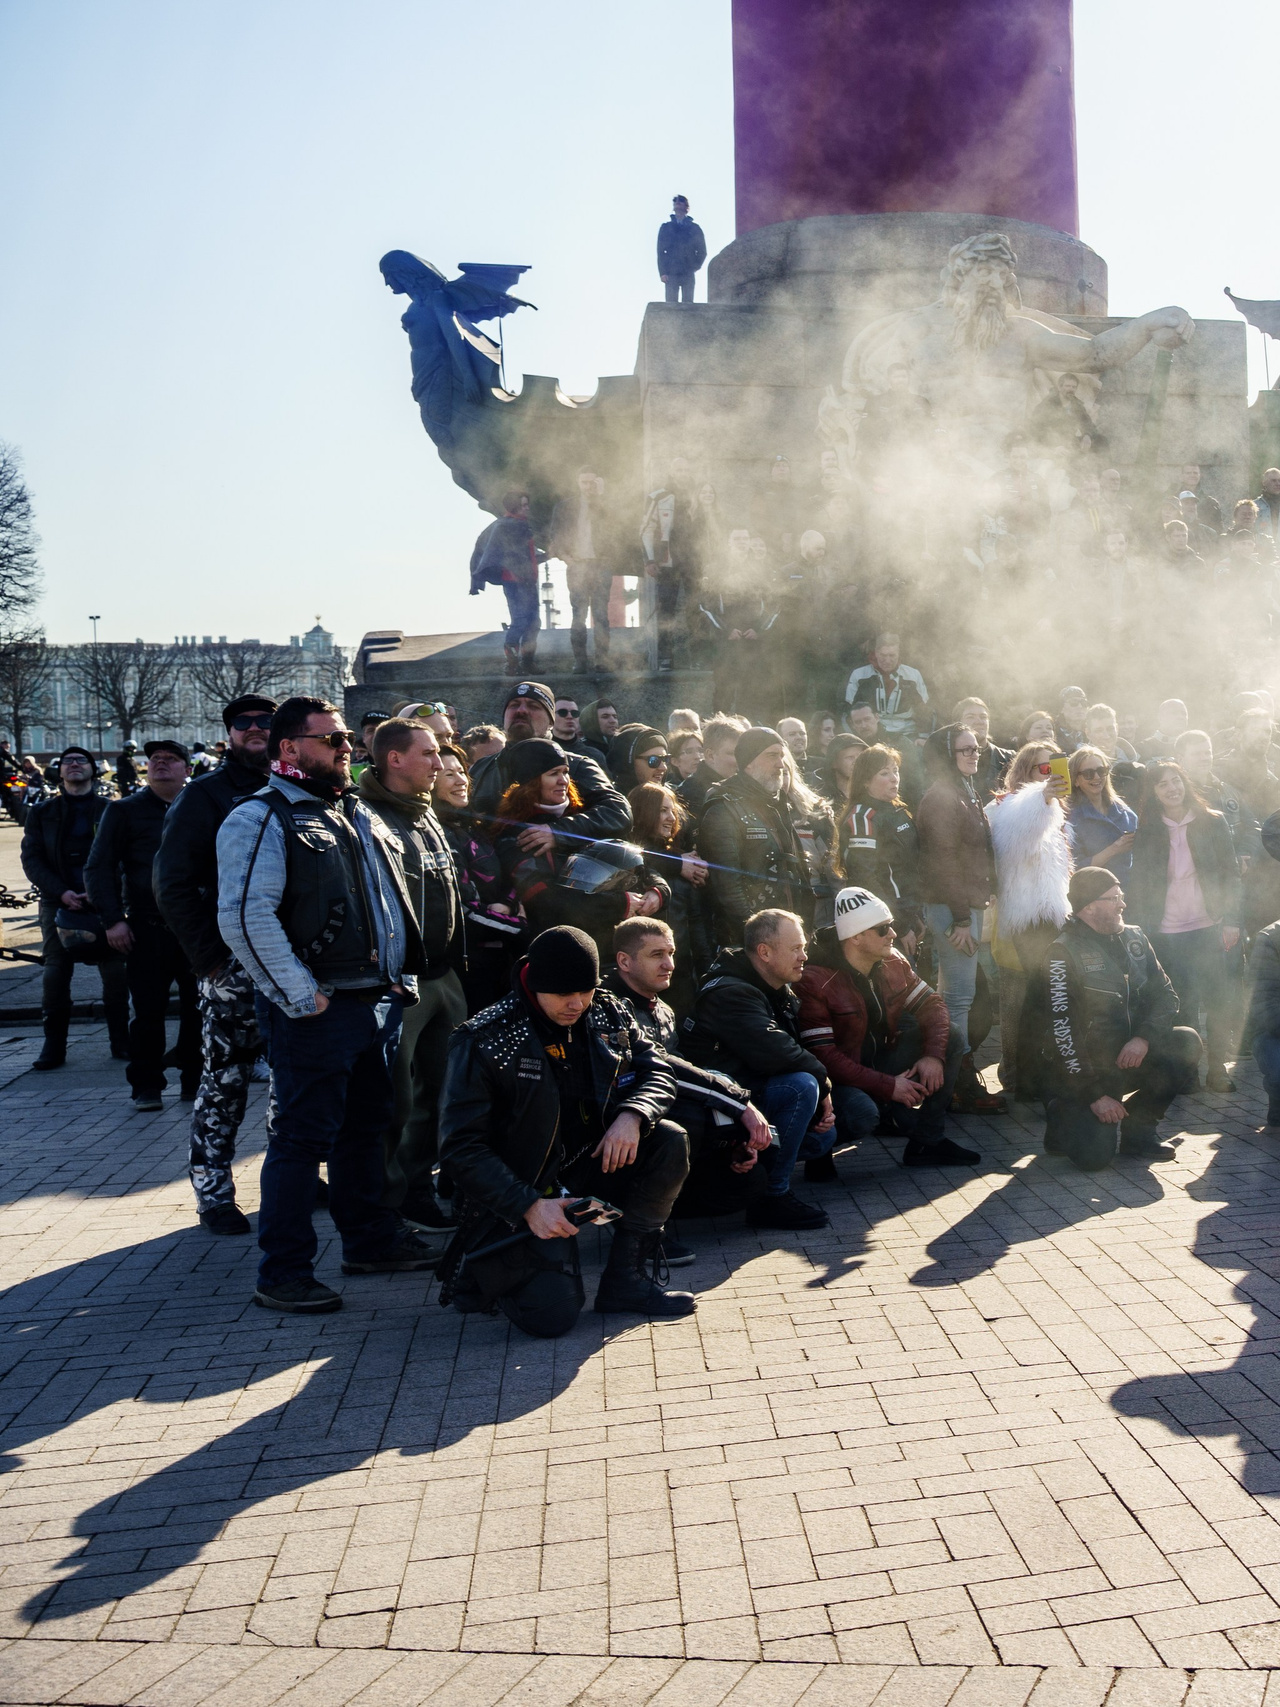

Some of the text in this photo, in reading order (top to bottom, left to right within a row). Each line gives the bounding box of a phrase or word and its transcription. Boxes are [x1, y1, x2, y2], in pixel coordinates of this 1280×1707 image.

[749, 864, 778, 909] USSIA
[836, 891, 874, 917] MON
[300, 902, 345, 960] USSIA
[1049, 960, 1081, 1074] NORMANS RIDERS MC
